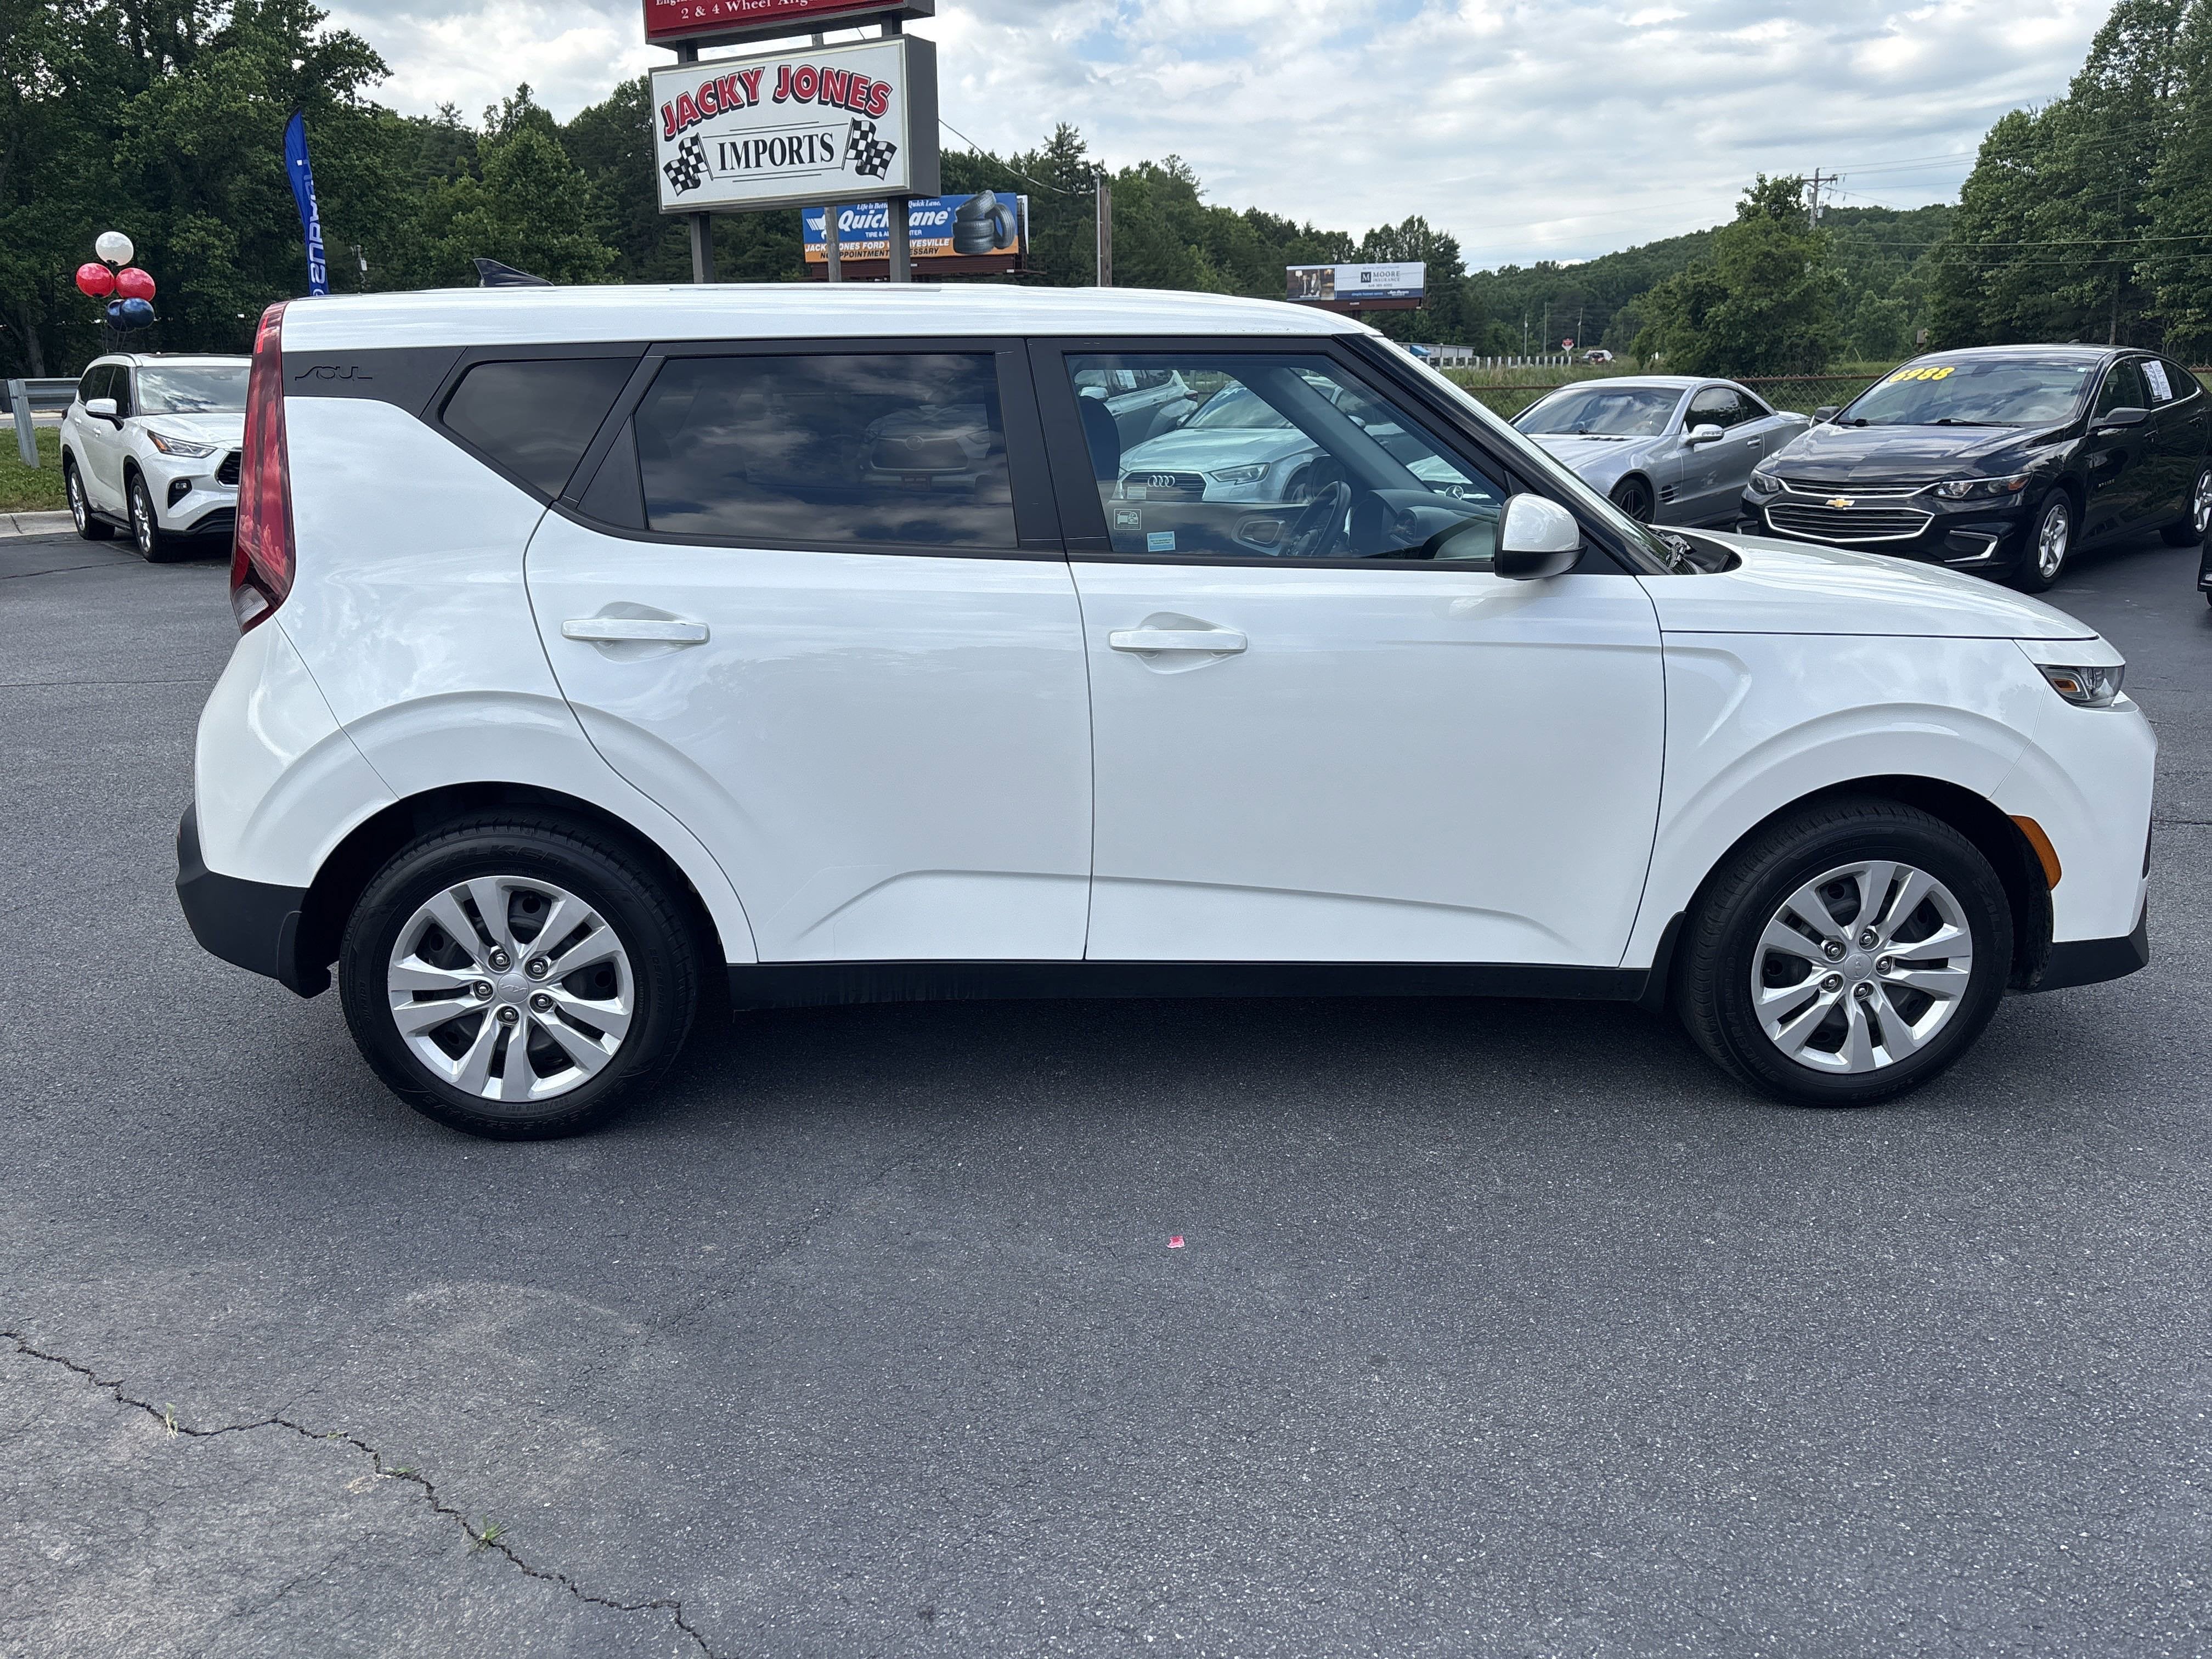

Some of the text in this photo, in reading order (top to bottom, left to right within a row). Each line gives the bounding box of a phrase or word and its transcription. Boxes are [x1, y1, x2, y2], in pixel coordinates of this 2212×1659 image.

[681, 8, 689, 19] 2
[695, 5, 707, 17] &
[712, 3, 720, 14] 4
[725, 0, 771, 12] Wheel
[662, 64, 893, 141] JACKY JONES
[717, 132, 834, 171] IMPORTS
[909, 211, 949, 227] ane
[805, 244, 828, 252] JACK
[839, 242, 862, 251] ONES
[862, 241, 885, 250] FORD
[910, 238, 950, 248] YESVILLE
[839, 250, 889, 258] PPOINTMENT
[295, 366, 373, 381] SOUL
